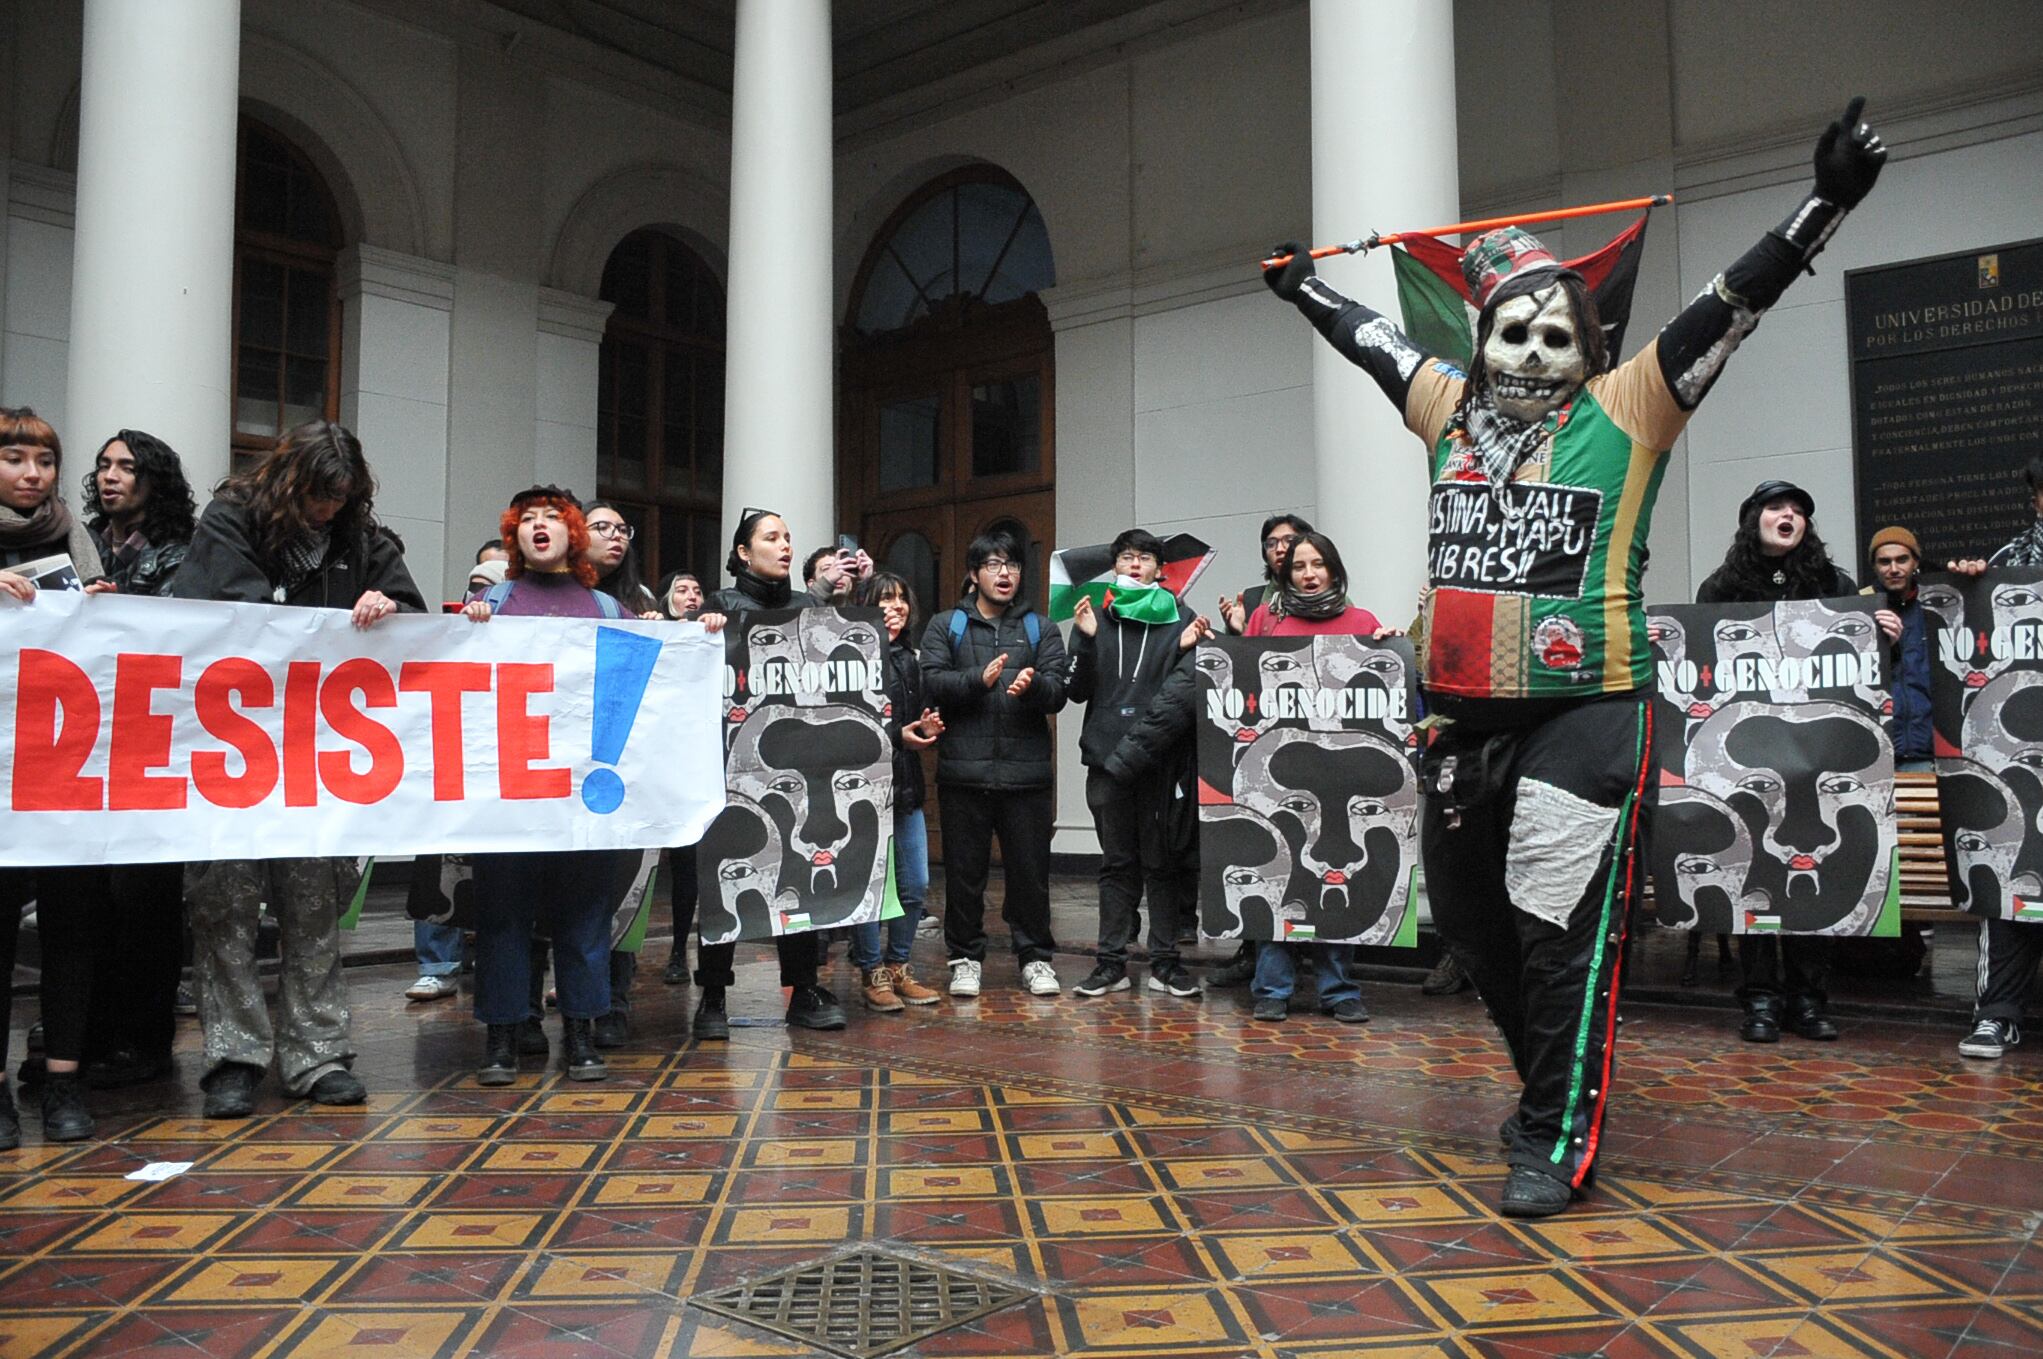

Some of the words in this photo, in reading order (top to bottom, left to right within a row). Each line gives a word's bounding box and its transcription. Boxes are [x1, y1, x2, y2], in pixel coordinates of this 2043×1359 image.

[1875, 295, 2013, 329] UNIVERSIDAD
[2017, 291, 2043, 310] DE
[1866, 334, 1897, 347] POR
[1903, 328, 1935, 343] LOS
[1940, 314, 2029, 338] DERECHOS
[1965, 370, 2014, 382] HUMANOS
[1939, 388, 1987, 401] DIGNIDAD
[1500, 518, 1585, 555] MAPU
[1938, 627, 1974, 662] NO
[748, 659, 884, 697] GENOCIDE
[1657, 659, 1698, 693] NO
[1714, 651, 1882, 693] GENOCIDE
[1206, 688, 1245, 719] NO
[1258, 687, 1408, 720] GENOCIDE
